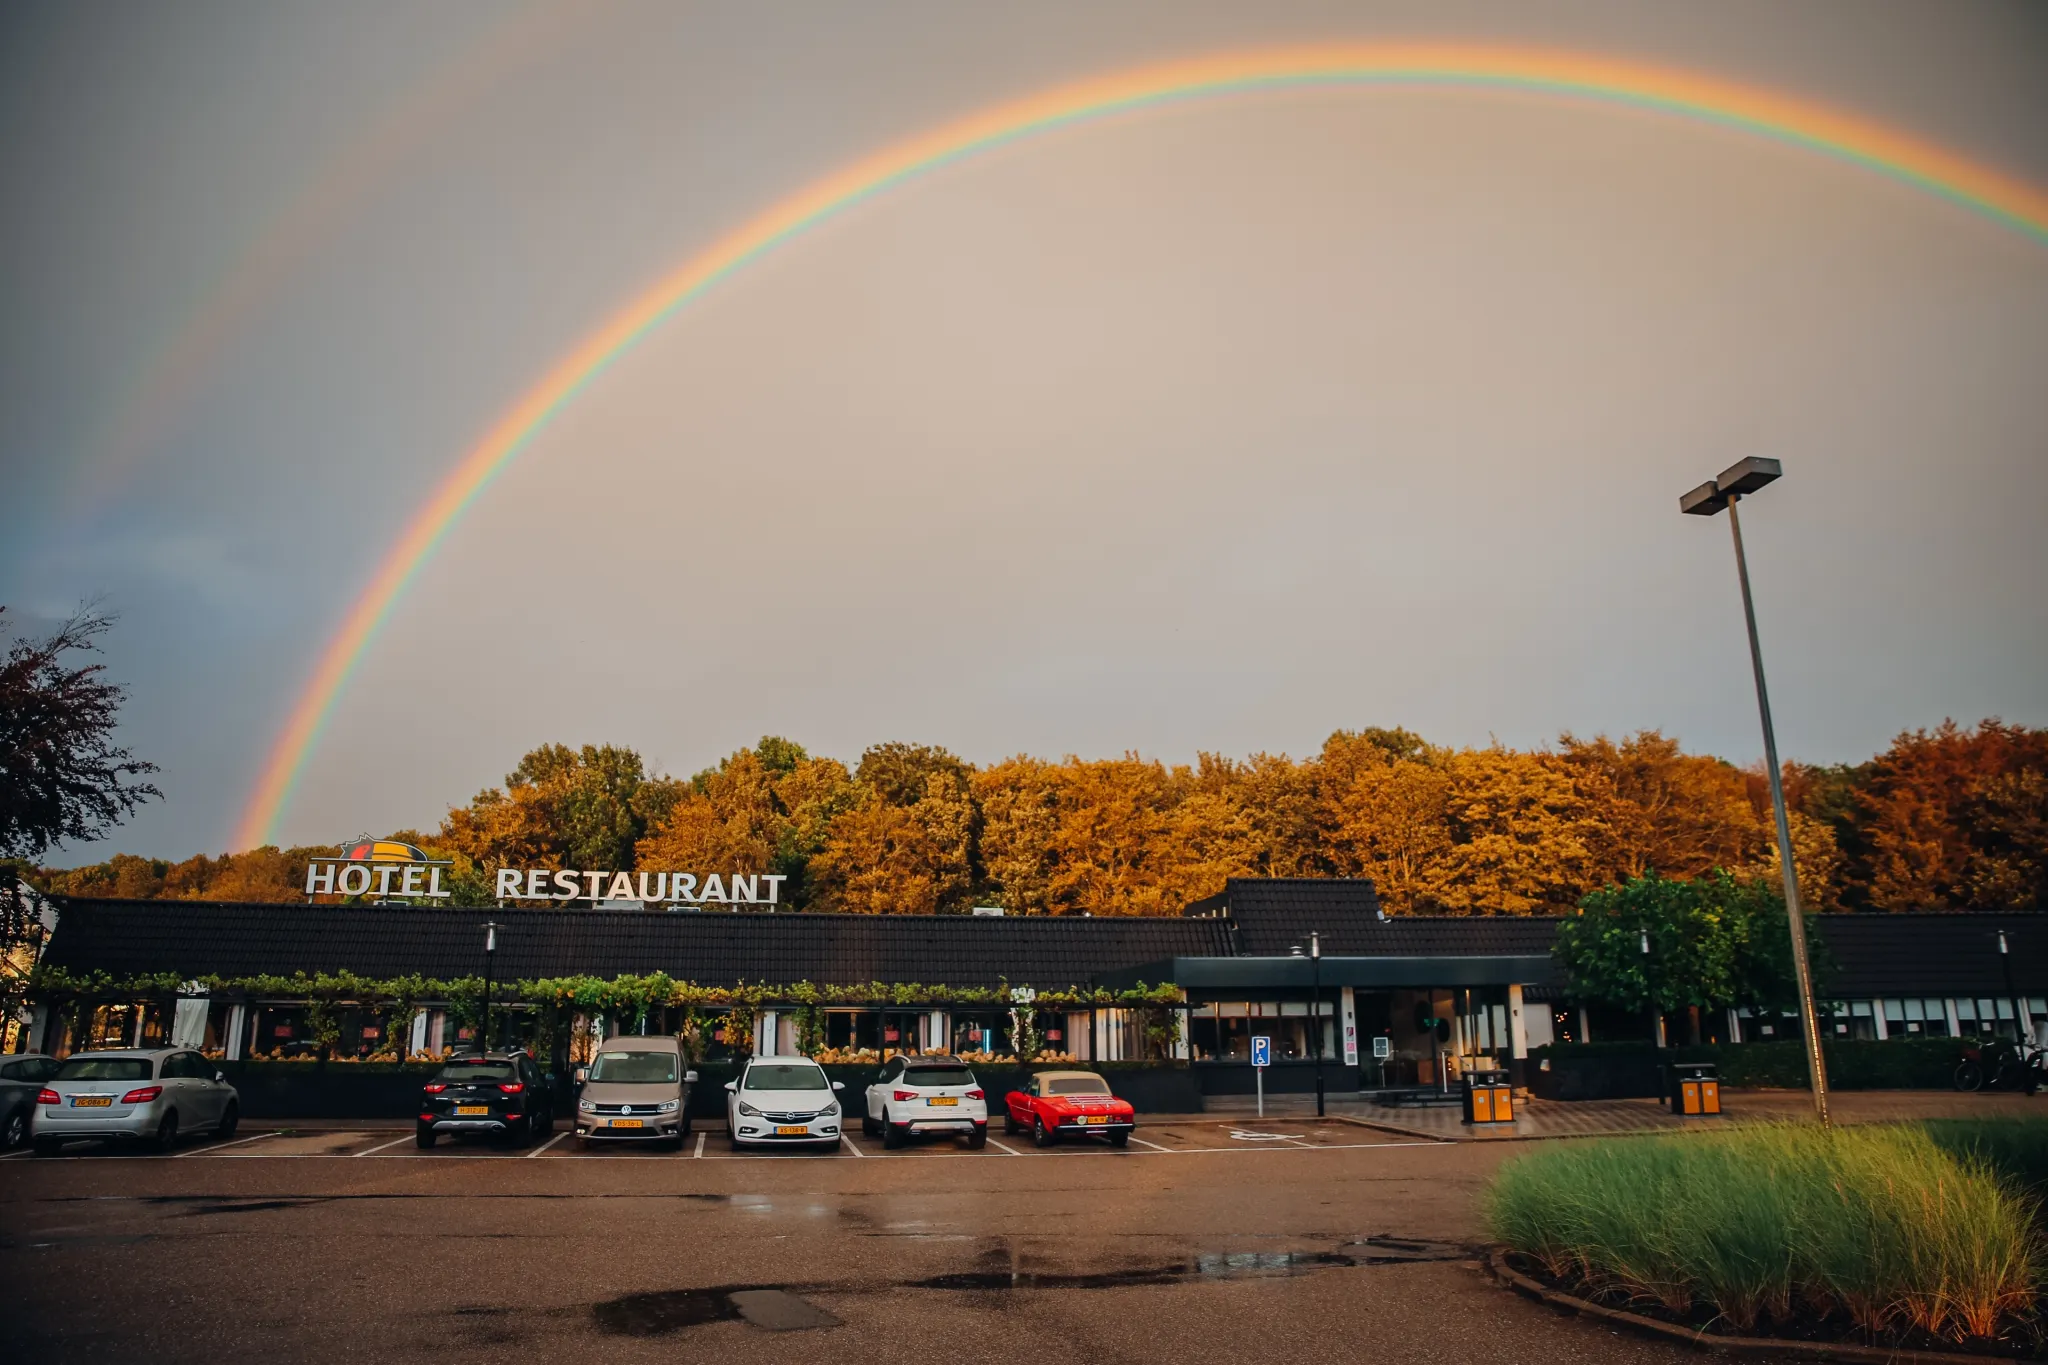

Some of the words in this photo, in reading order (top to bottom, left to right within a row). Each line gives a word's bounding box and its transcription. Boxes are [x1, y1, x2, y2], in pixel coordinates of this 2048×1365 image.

[306, 863, 451, 897] HOTEL
[496, 868, 787, 904] RESTAURANT
[1255, 1039, 1267, 1054] P
